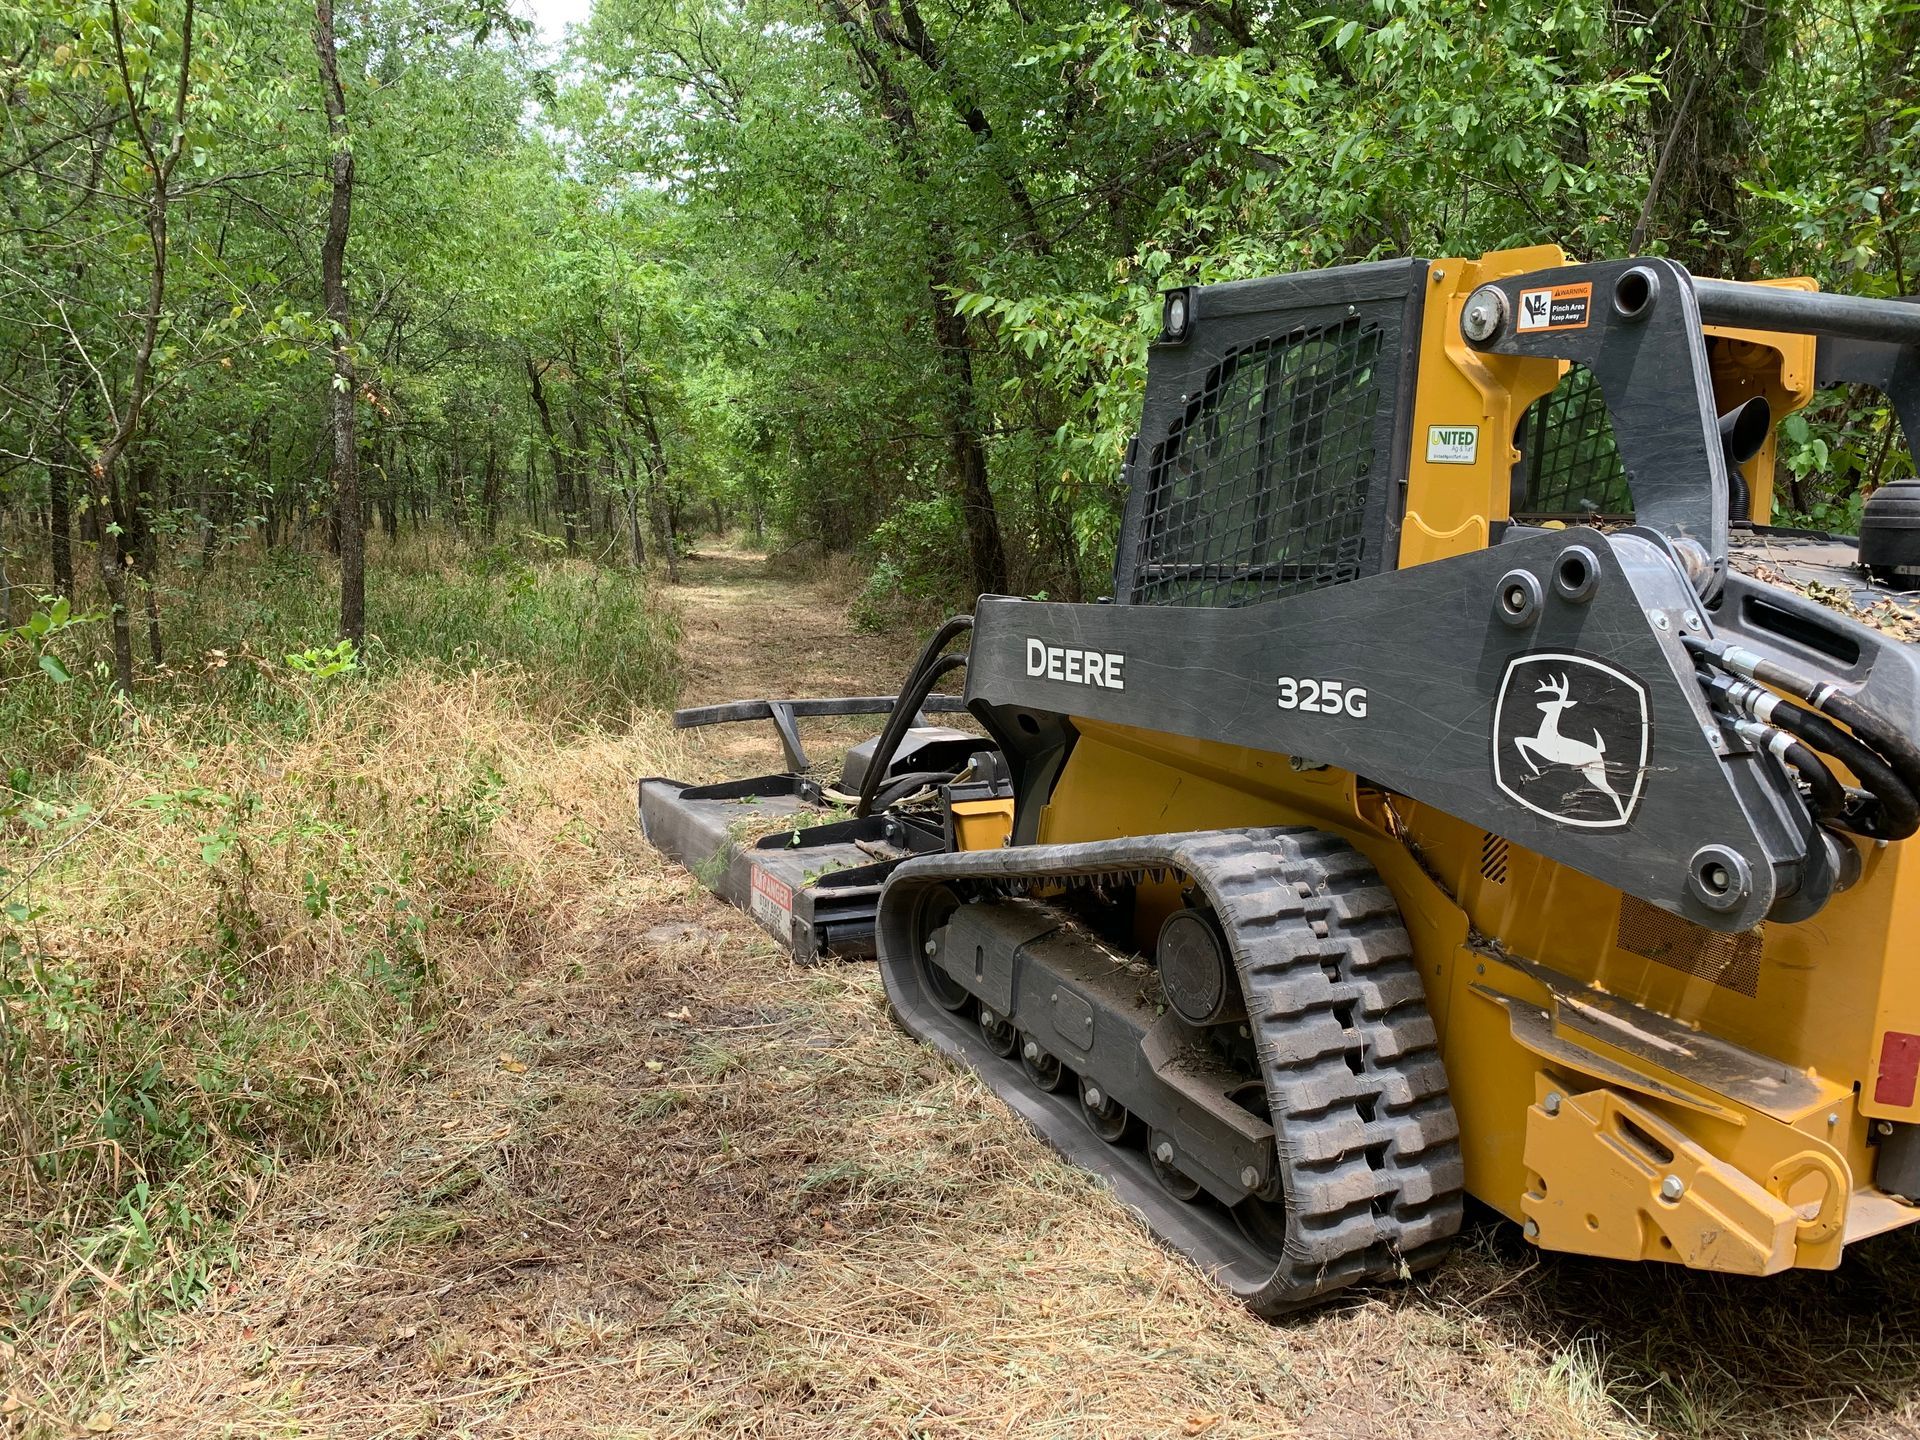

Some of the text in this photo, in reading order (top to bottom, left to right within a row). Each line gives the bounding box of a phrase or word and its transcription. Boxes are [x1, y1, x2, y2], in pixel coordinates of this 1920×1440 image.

[1560, 287, 1588, 296] WARNING
[1552, 303, 1585, 312] Pinch Area
[1551, 313, 1580, 322] Keep Away
[1431, 431, 1474, 445] UNITED
[1027, 638, 1124, 689] DEERE
[1278, 677, 1367, 718] 325G
[761, 872, 789, 907] DANGER
